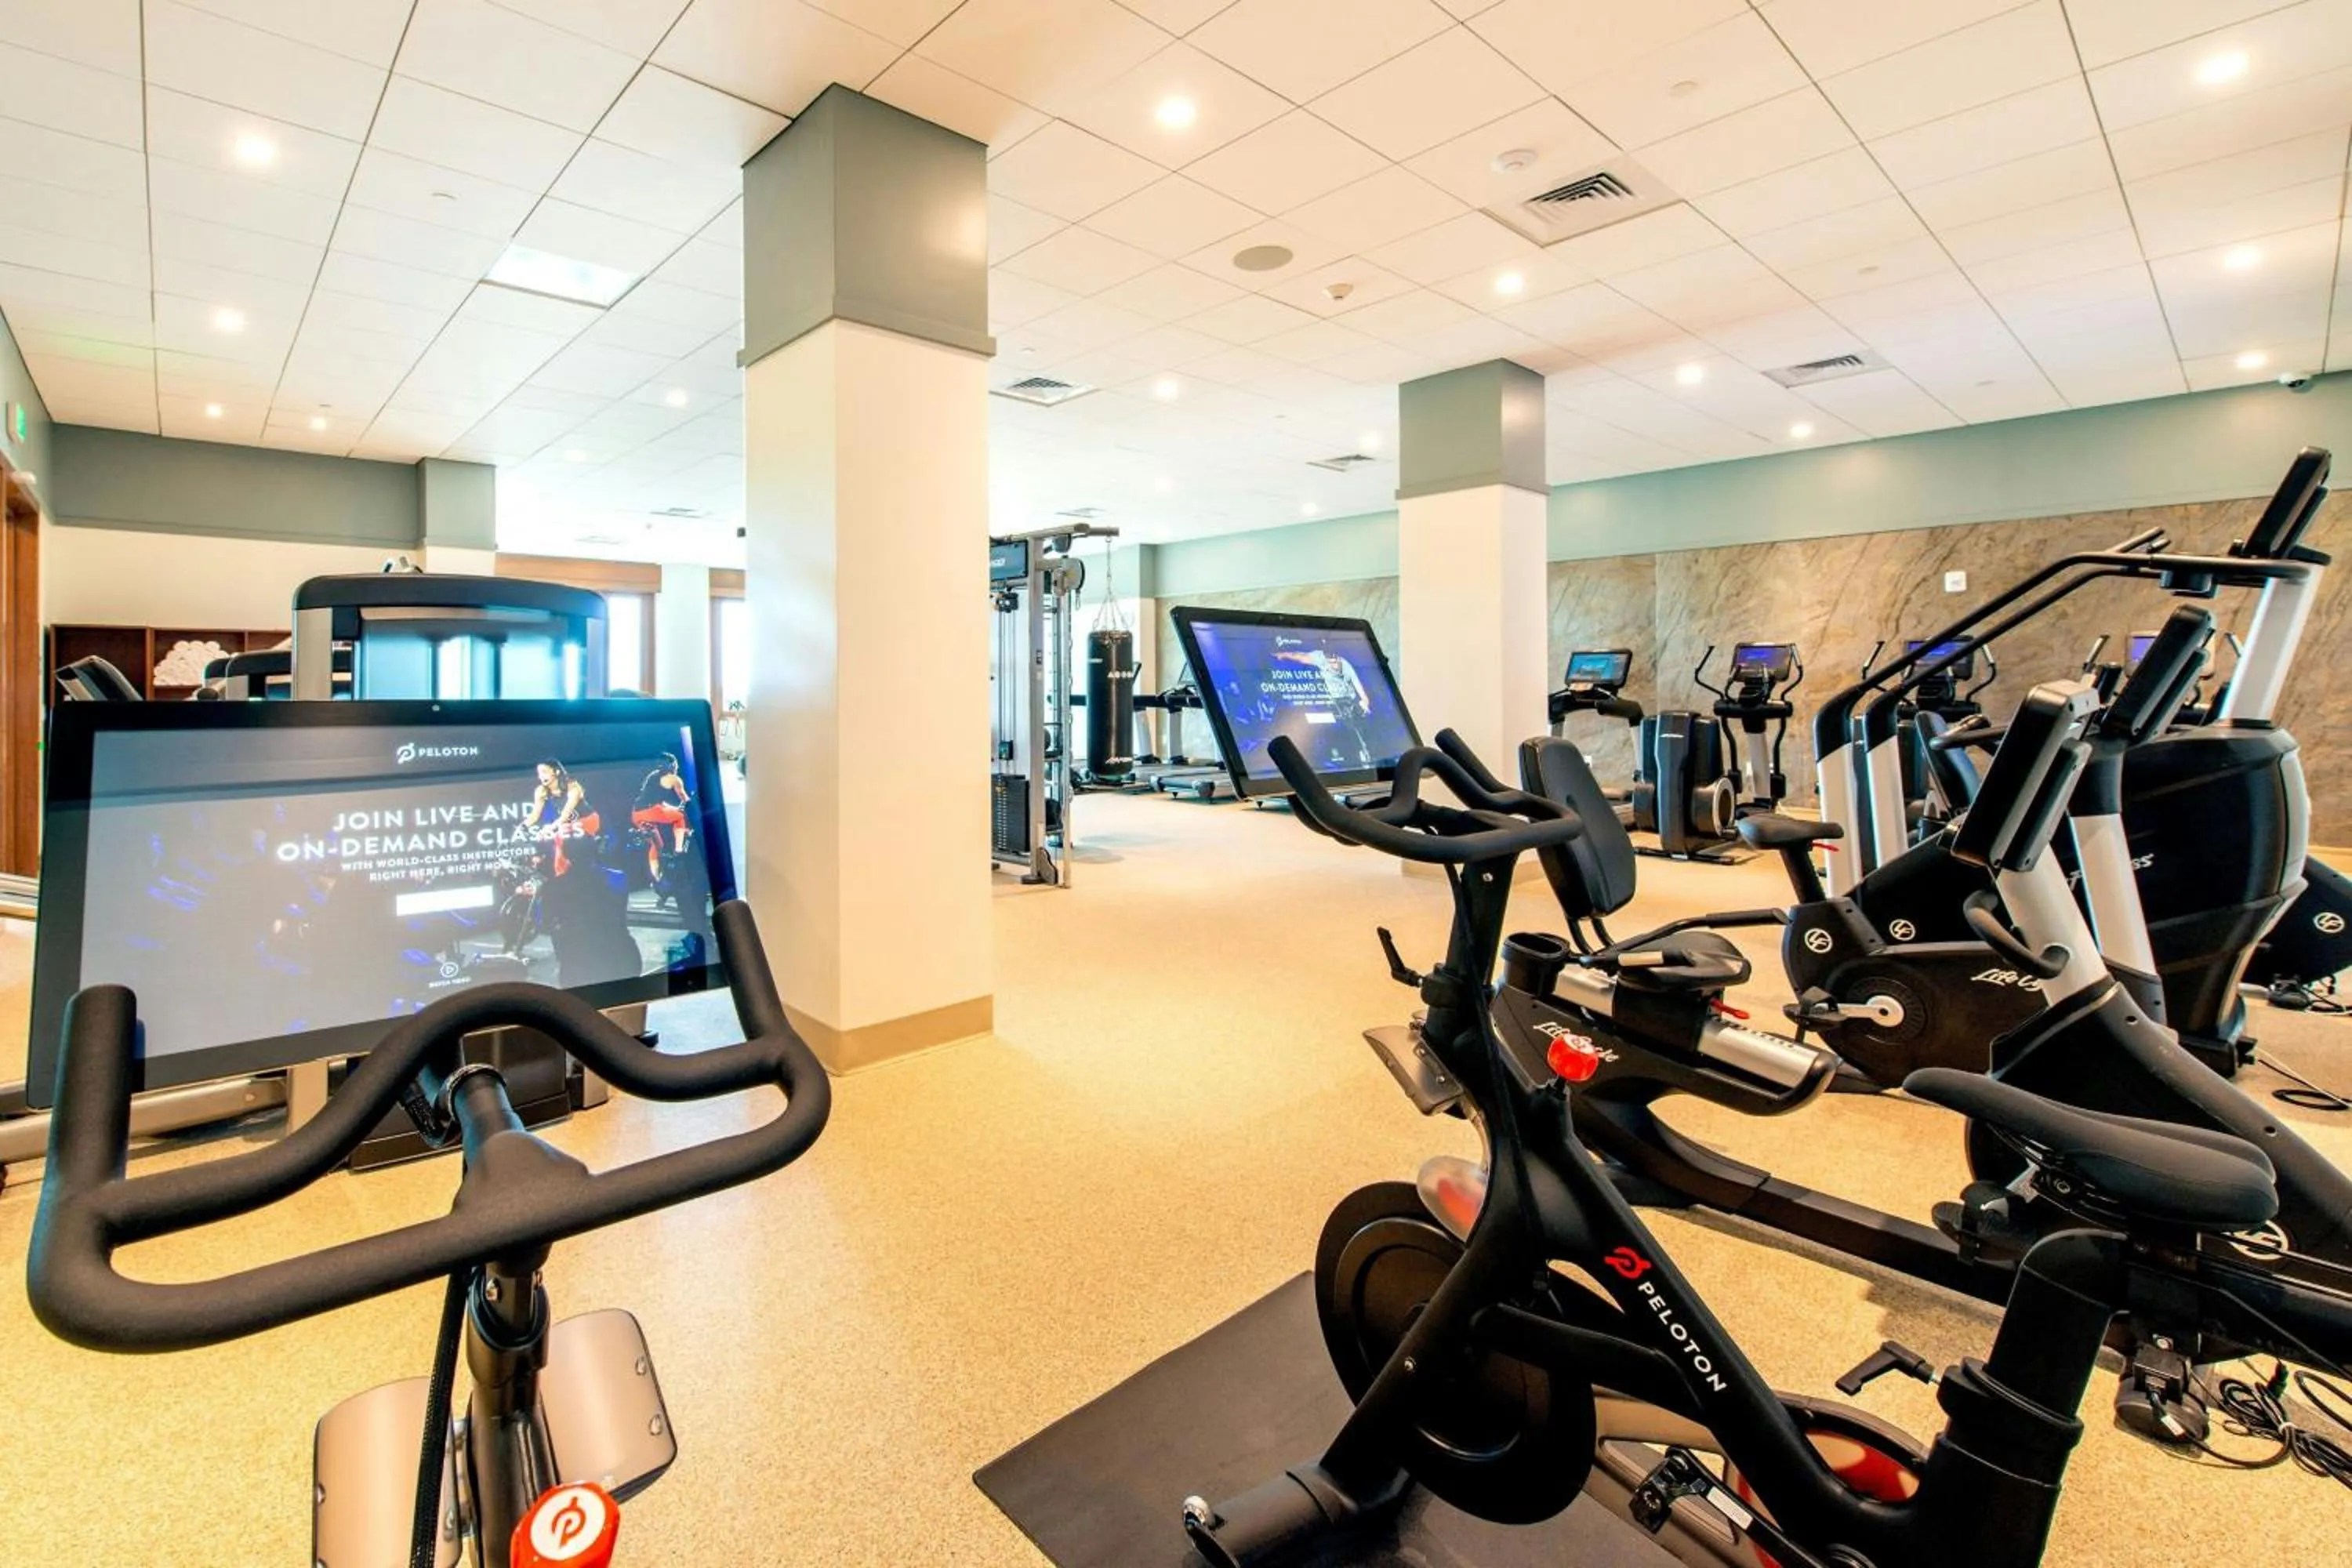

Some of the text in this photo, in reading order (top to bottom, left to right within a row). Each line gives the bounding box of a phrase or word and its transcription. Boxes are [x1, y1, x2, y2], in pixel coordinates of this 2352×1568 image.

[419, 746, 478, 757] PELOTON
[332, 801, 536, 833] JOIN LIVE AND
[276, 822, 586, 862] ON-DEMAND CLASSES
[340, 846, 536, 871] WITH WORLD-CLASS INSTRUCTORS
[368, 870, 406, 882] RIGHT
[447, 862, 481, 874] RIGHT
[1637, 1281, 1728, 1392] PELOTON
